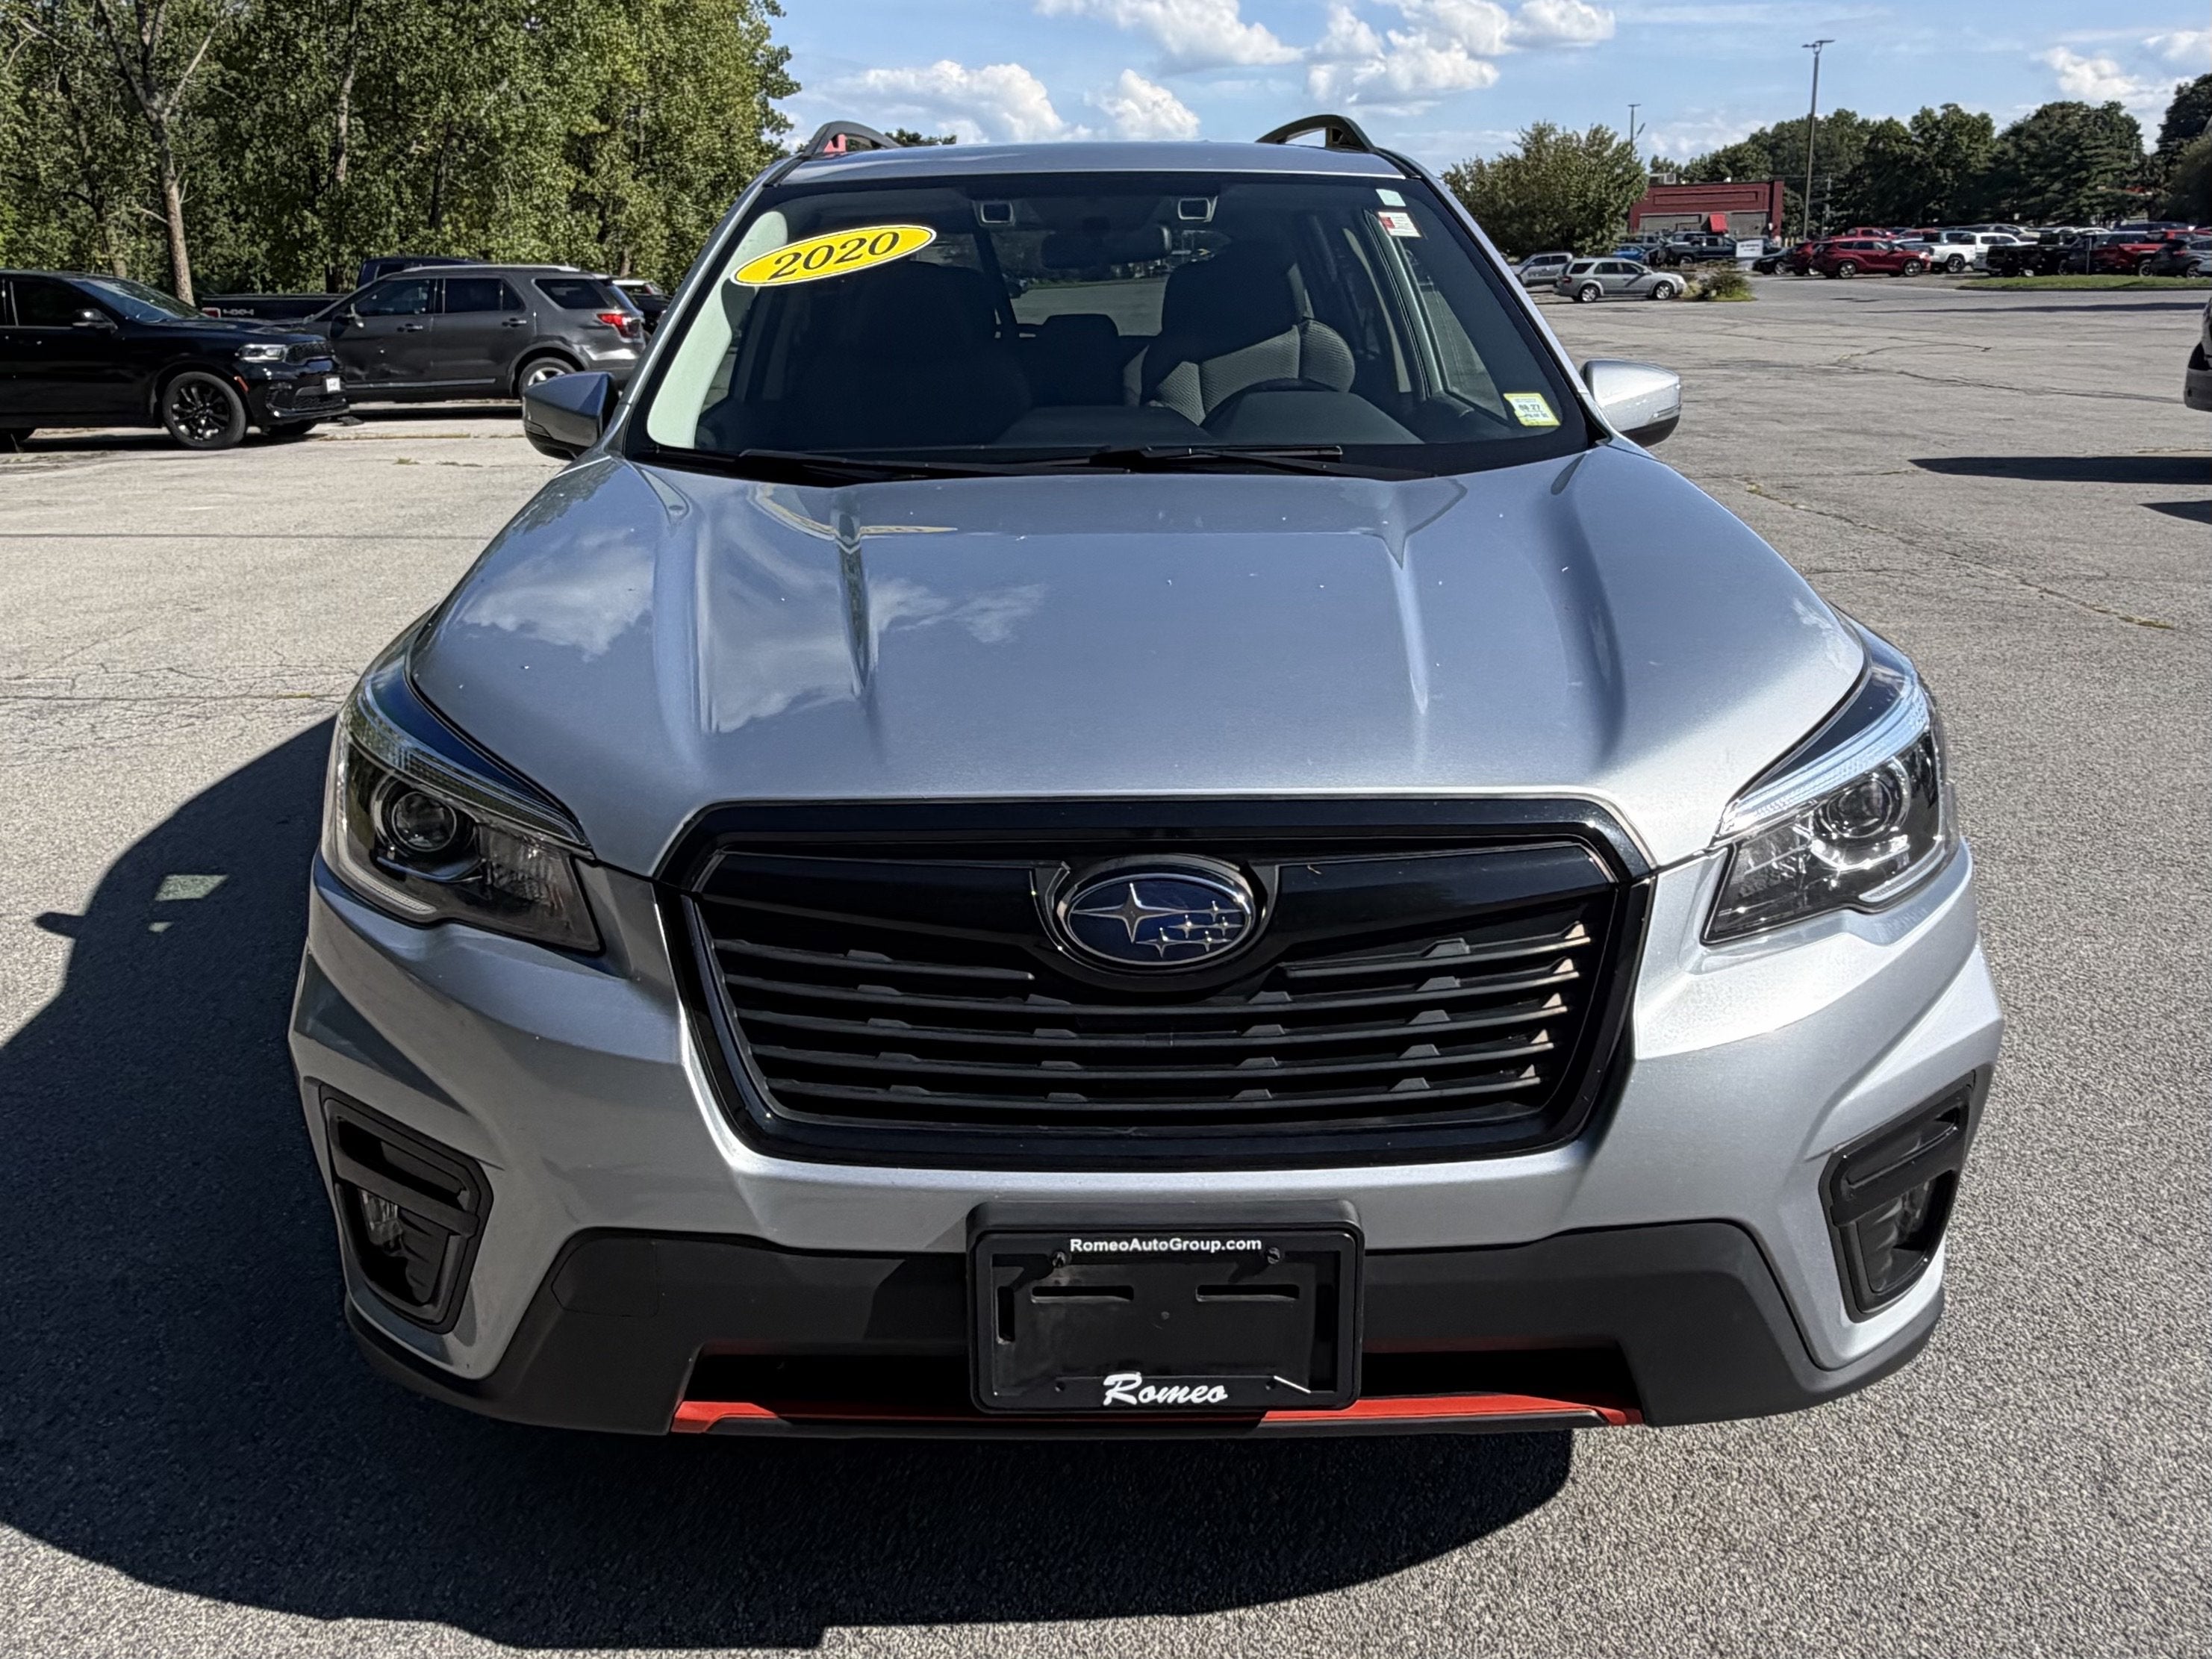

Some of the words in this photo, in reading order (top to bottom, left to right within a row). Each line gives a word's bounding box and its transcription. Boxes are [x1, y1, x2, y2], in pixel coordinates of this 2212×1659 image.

[767, 231, 900, 281] 2020
[1070, 1238, 1262, 1254] RomeoAutoGroup.com
[1103, 1372, 1229, 1406] Romeo
